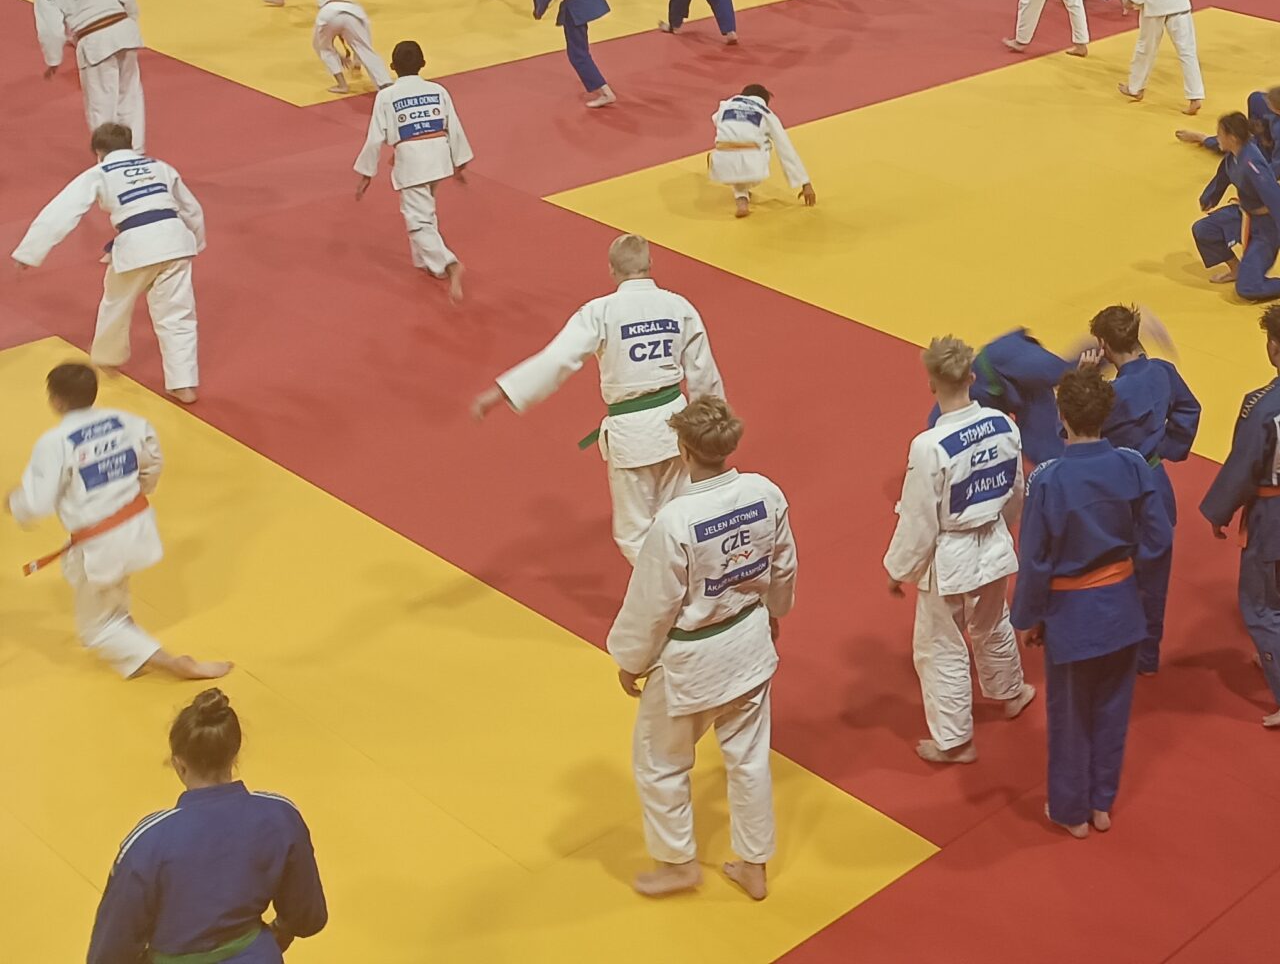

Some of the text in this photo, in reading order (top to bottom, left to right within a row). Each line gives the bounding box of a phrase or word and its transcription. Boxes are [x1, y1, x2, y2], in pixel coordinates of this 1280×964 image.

[409, 110, 431, 119] CZE
[123, 167, 152, 177] CZE
[629, 339, 673, 363] CZE
[703, 520, 728, 536] JELEN
[721, 529, 751, 555] CZE
